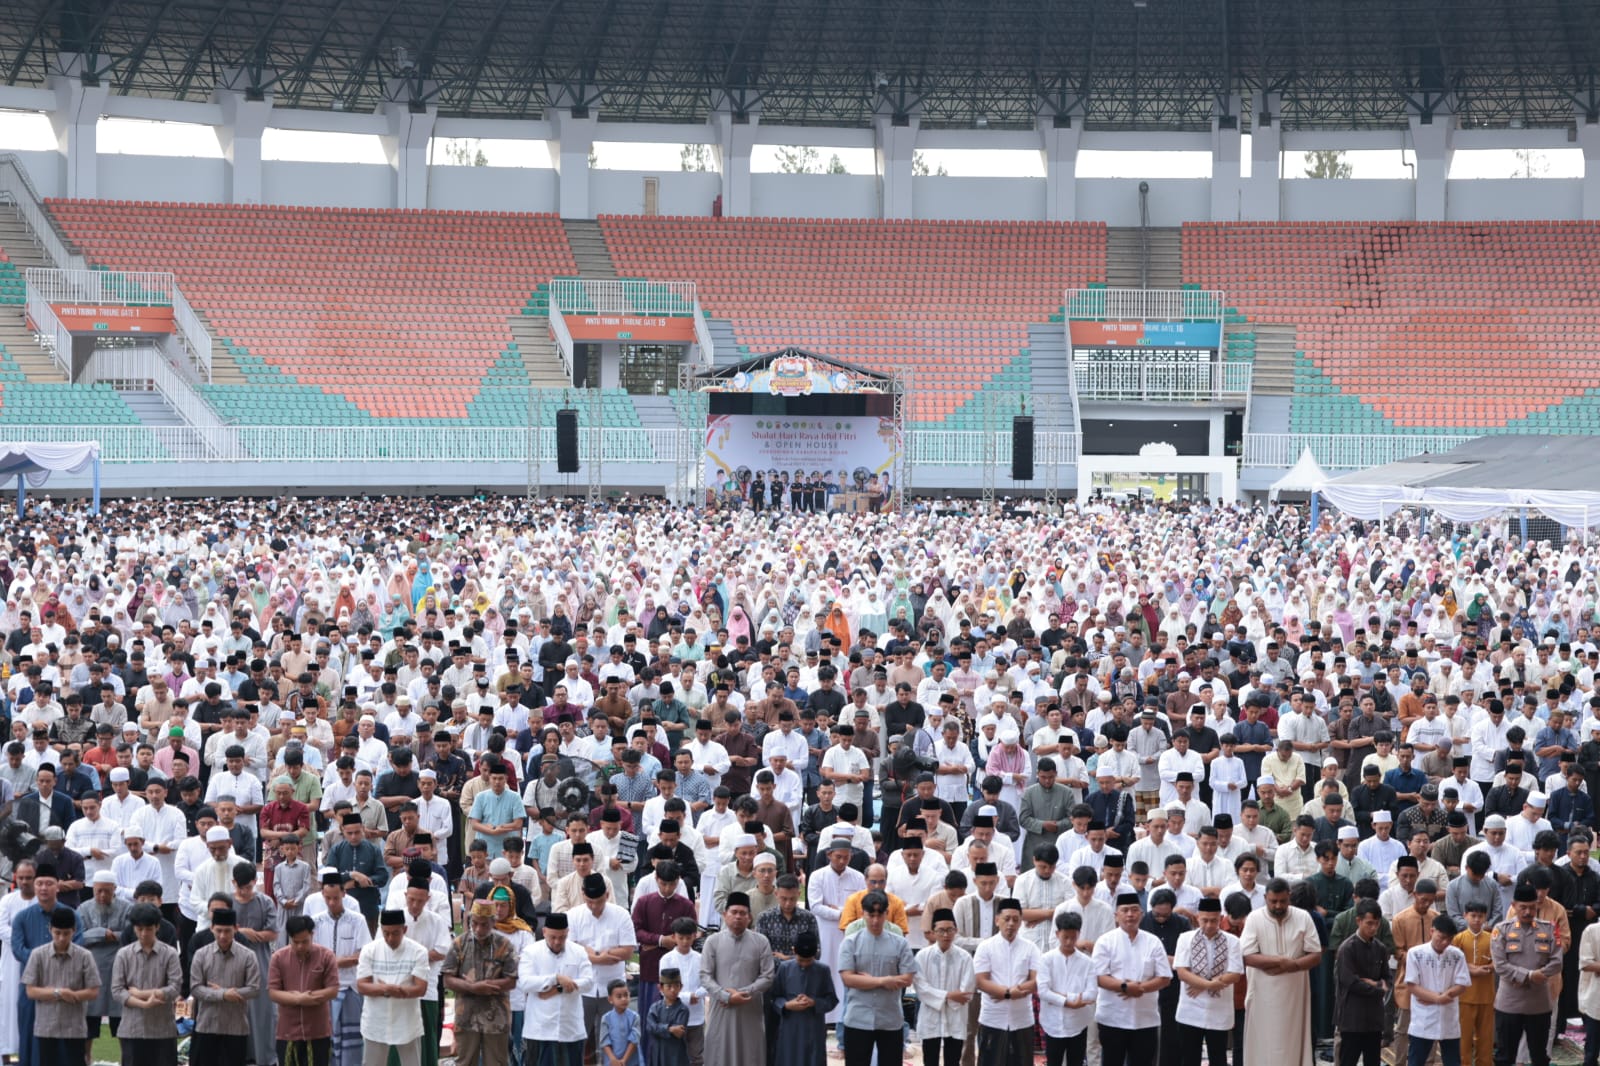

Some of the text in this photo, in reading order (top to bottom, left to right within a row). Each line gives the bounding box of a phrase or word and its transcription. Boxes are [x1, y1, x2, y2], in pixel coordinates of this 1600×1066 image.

[120, 308, 134, 317] GATE
[643, 318, 657, 327] GATE
[658, 318, 666, 327] 15
[1161, 324, 1174, 333] GATE
[1176, 324, 1184, 333] 16
[752, 431, 856, 441] Shalat Hari Raya Idul Fitri
[806, 441, 839, 449] HOUSE
